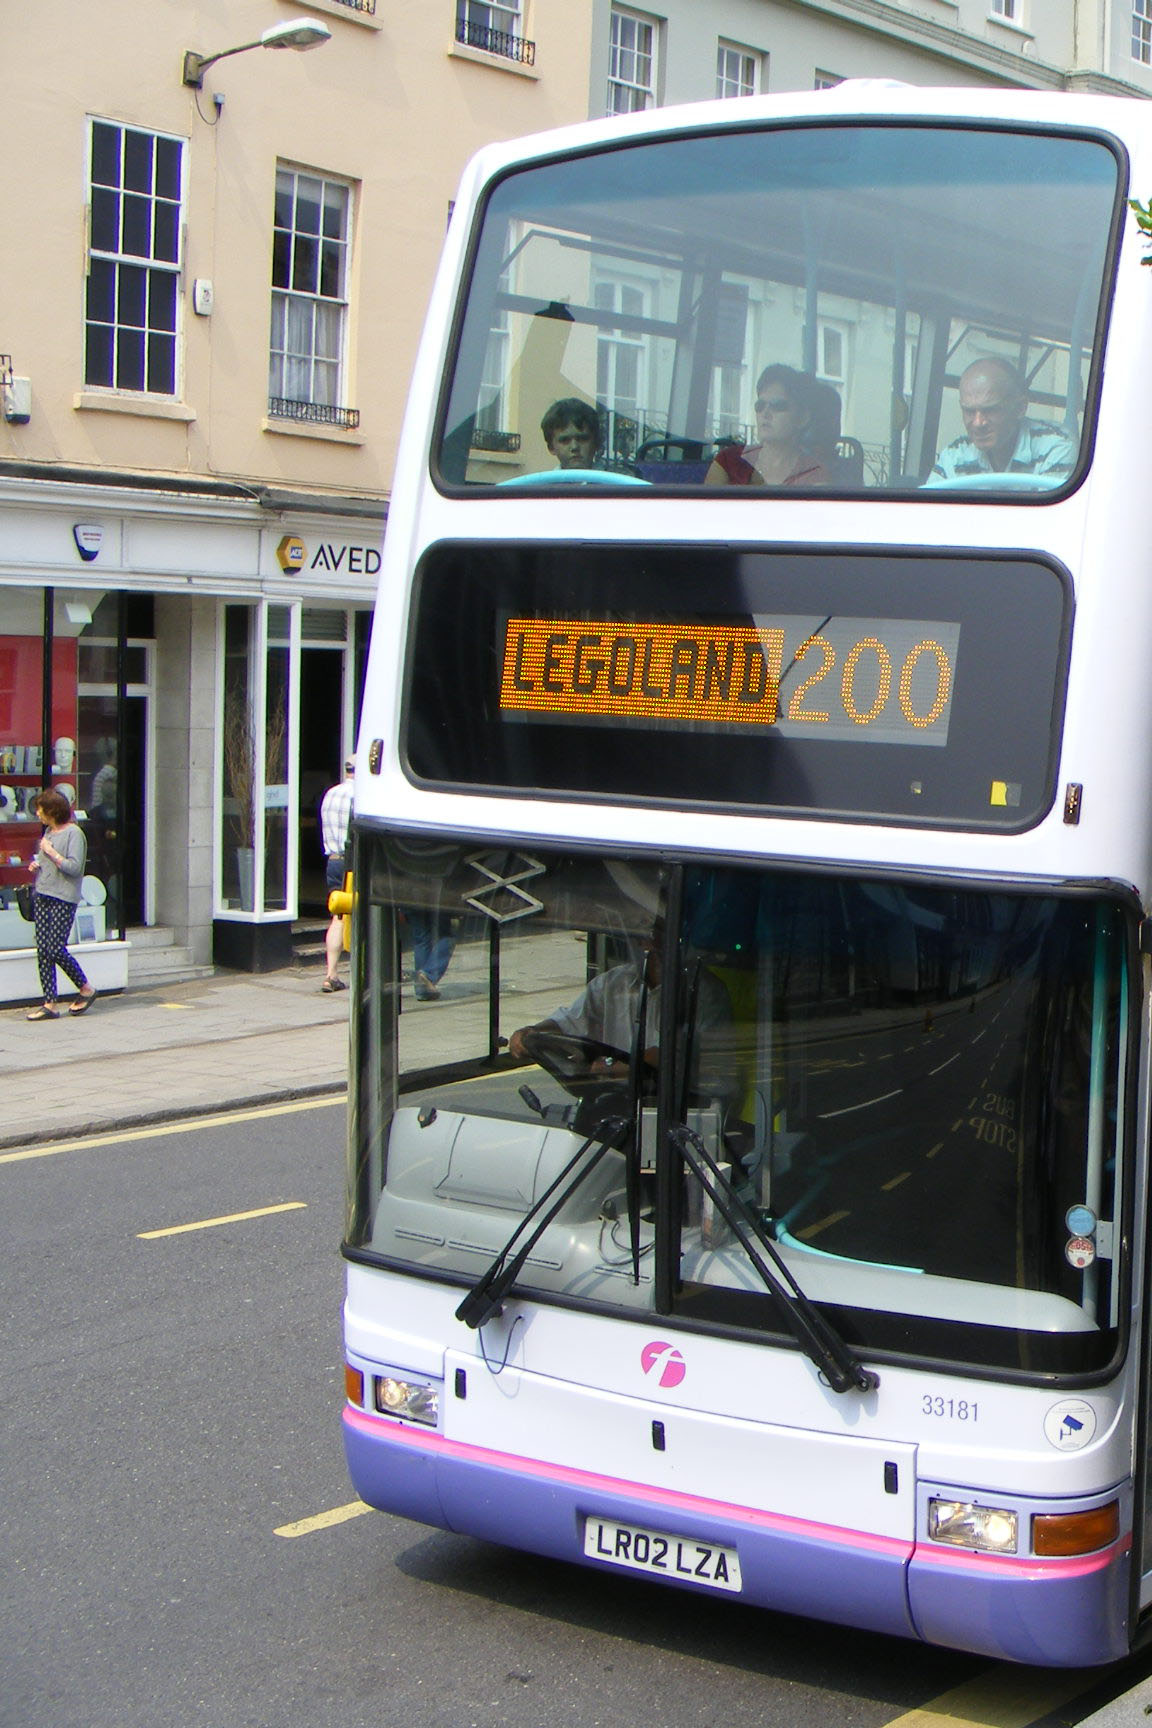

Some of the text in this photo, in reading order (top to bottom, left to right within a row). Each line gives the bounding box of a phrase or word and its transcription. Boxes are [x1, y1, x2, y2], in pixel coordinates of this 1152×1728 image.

[512, 632, 952, 729] LEGOLAND 200
[922, 1394, 979, 1423] 33181
[597, 1524, 730, 1584] LR02 LZA
